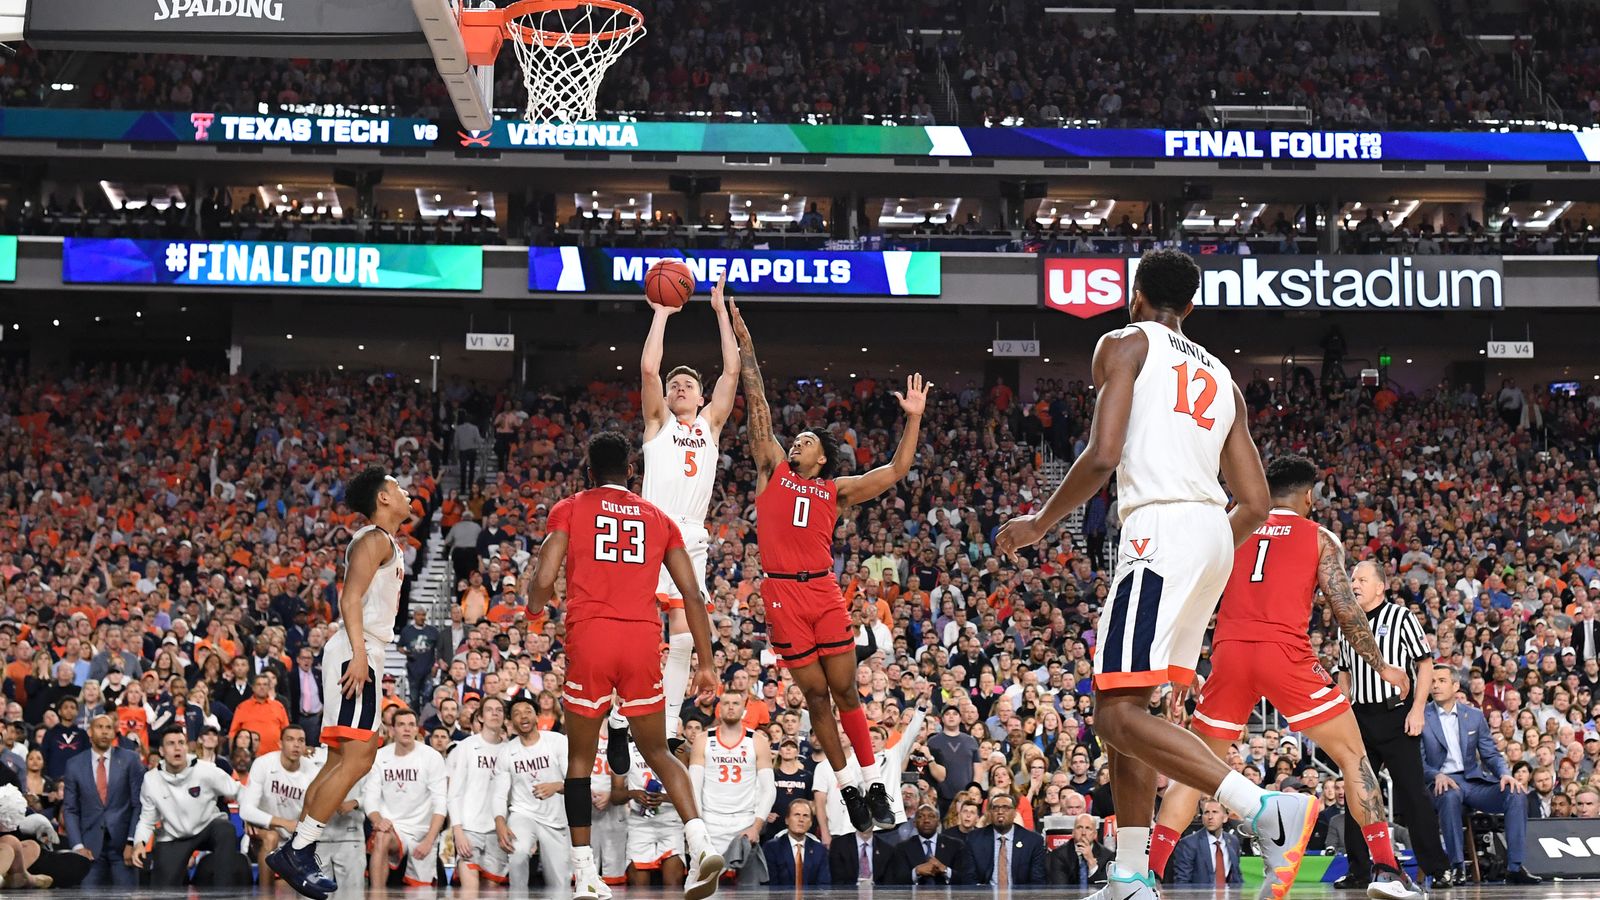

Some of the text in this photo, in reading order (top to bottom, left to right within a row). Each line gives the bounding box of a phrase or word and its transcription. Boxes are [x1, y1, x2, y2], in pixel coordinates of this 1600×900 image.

[220, 116, 312, 142] TEXAS
[316, 118, 390, 143] TECH
[506, 122, 639, 147] VIRGINIA
[1165, 130, 1358, 159] FINAL FOUR
[165, 242, 380, 284] #FINALFOUR
[612, 256, 851, 284] MNEAPOLIS
[1048, 268, 1123, 305] us
[470, 336, 510, 347] V1 V2
[997, 342, 1036, 353] V2 V3
[1491, 344, 1529, 354] V3 V4
[1171, 360, 1218, 431] 12
[684, 450, 698, 478] 5
[780, 477, 830, 501] TEXAS TECH
[601, 499, 641, 516] CULVER
[793, 496, 811, 528] 0
[594, 514, 646, 565] 23
[1250, 538, 1271, 583] 1
[477, 755, 498, 769] FAM
[514, 755, 550, 774] FAMILY
[711, 756, 748, 764] VIRGINIA
[384, 768, 419, 782] FAMILY
[718, 764, 742, 783] 33
[271, 780, 305, 801] FAMILY
